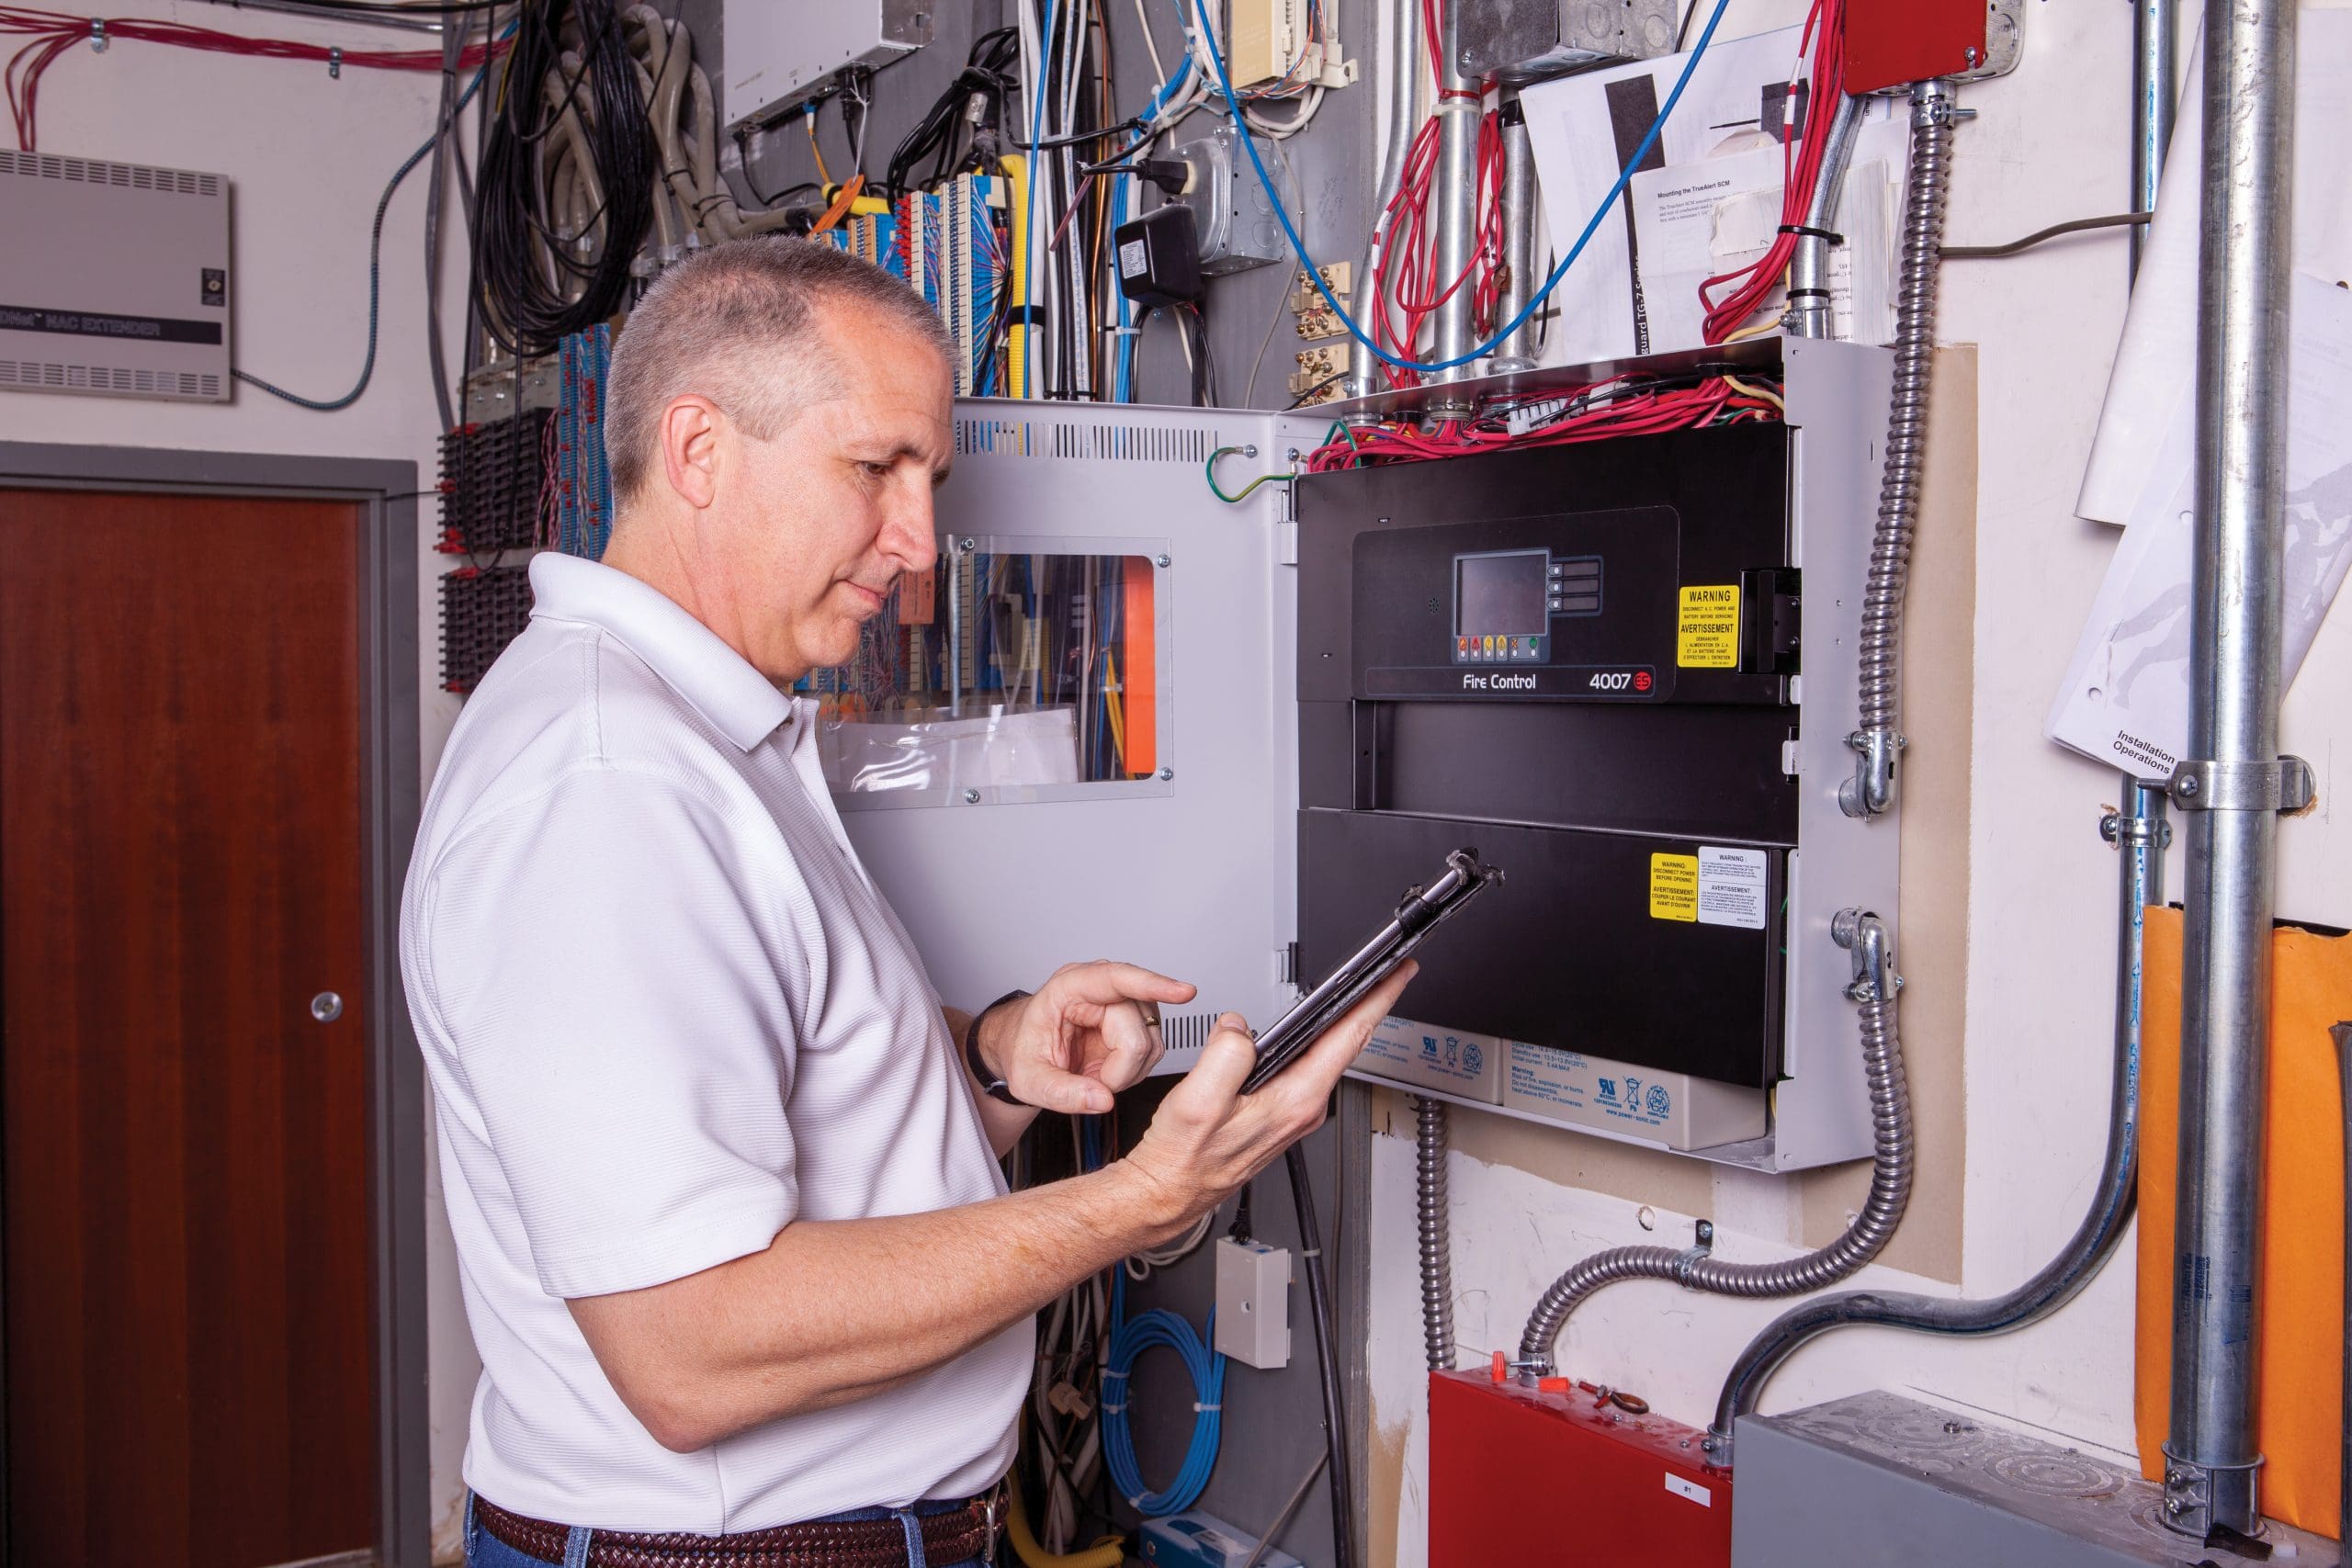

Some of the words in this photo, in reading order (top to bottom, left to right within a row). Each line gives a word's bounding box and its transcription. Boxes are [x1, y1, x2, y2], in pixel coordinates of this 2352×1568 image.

[1657, 189, 1682, 198] Mounting
[1692, 184, 1716, 192] TrueAlert
[1635, 292, 1646, 320] TG-7
[46, 315, 79, 330] NAC
[82, 317, 161, 336] EXTENDER
[1638, 322, 1649, 355] guard
[1690, 590, 1731, 603] WARNING
[1680, 624, 1734, 633] AVERTISSEMENT
[1463, 673, 1487, 689] Fire
[1490, 673, 1536, 689] Control
[1589, 673, 1632, 689] 4007
[2117, 729, 2176, 764] Installation
[2113, 740, 2170, 774] Operations
[1719, 854, 1744, 863] WARNING
